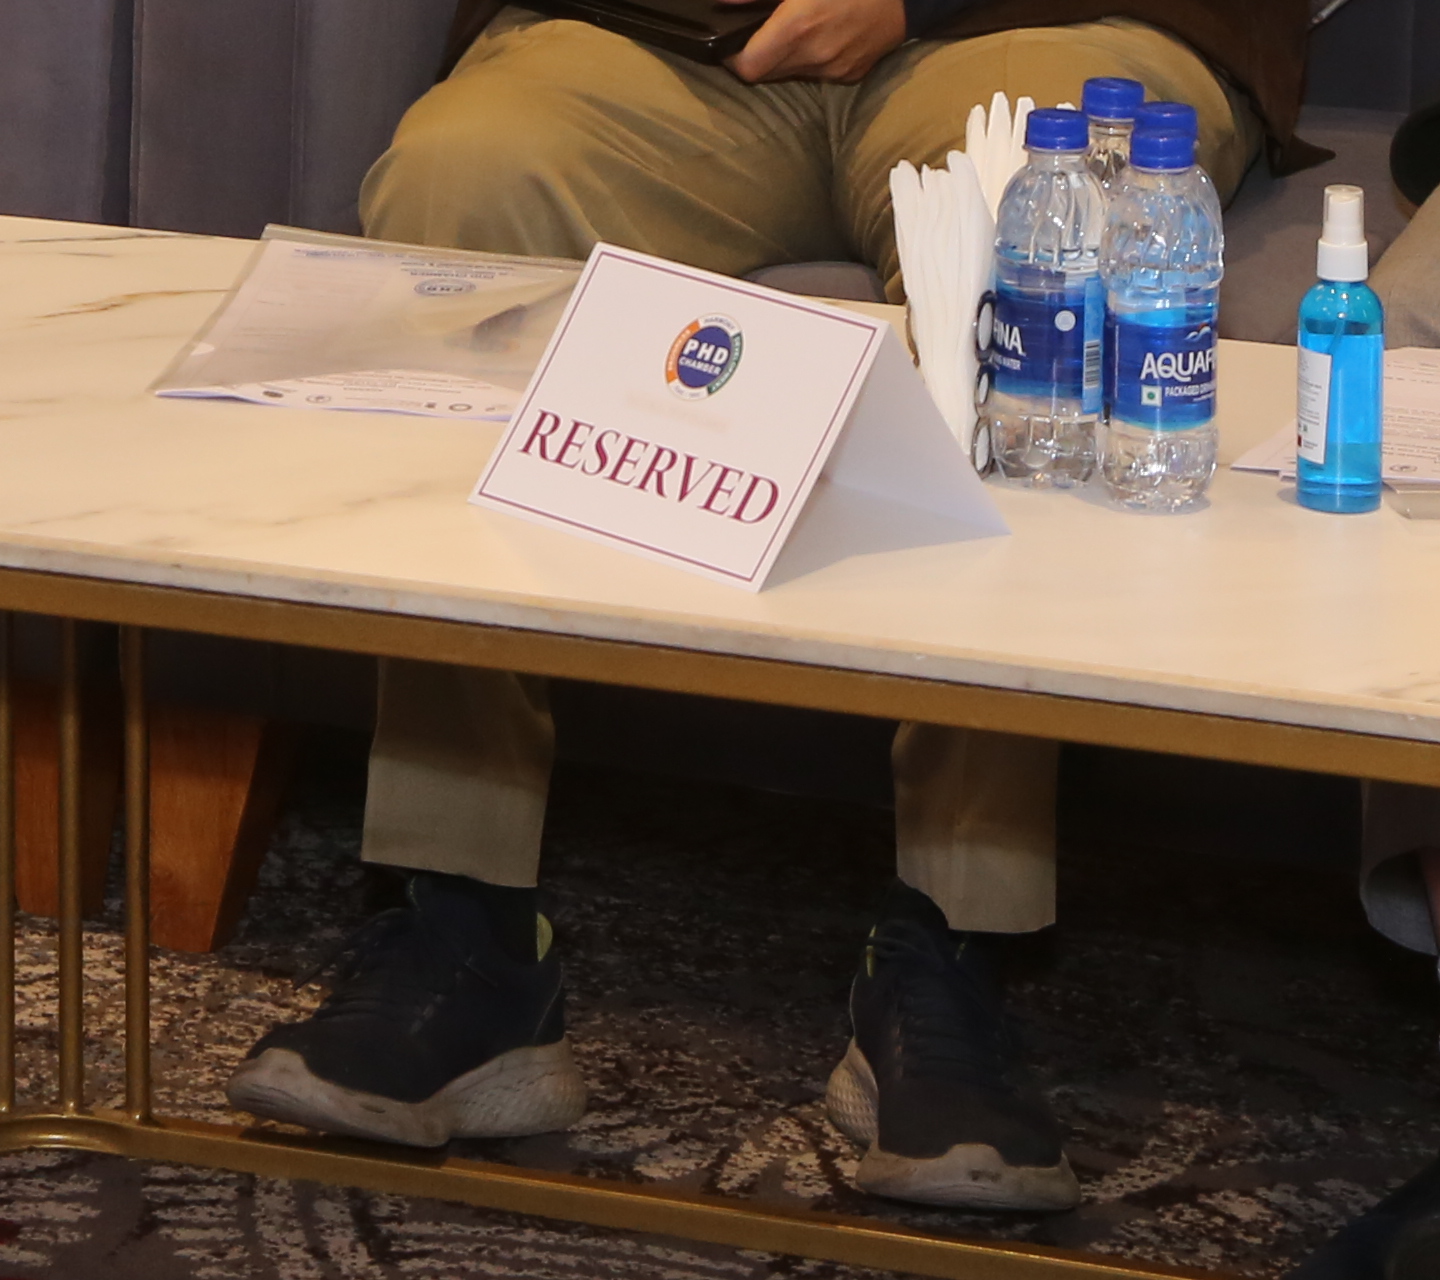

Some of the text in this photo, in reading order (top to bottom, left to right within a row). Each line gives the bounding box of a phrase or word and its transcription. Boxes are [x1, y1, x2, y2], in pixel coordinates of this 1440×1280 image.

[682, 338, 729, 365] PHD
[678, 356, 722, 376] CHAMBER
[518, 408, 780, 525] RESERVED
